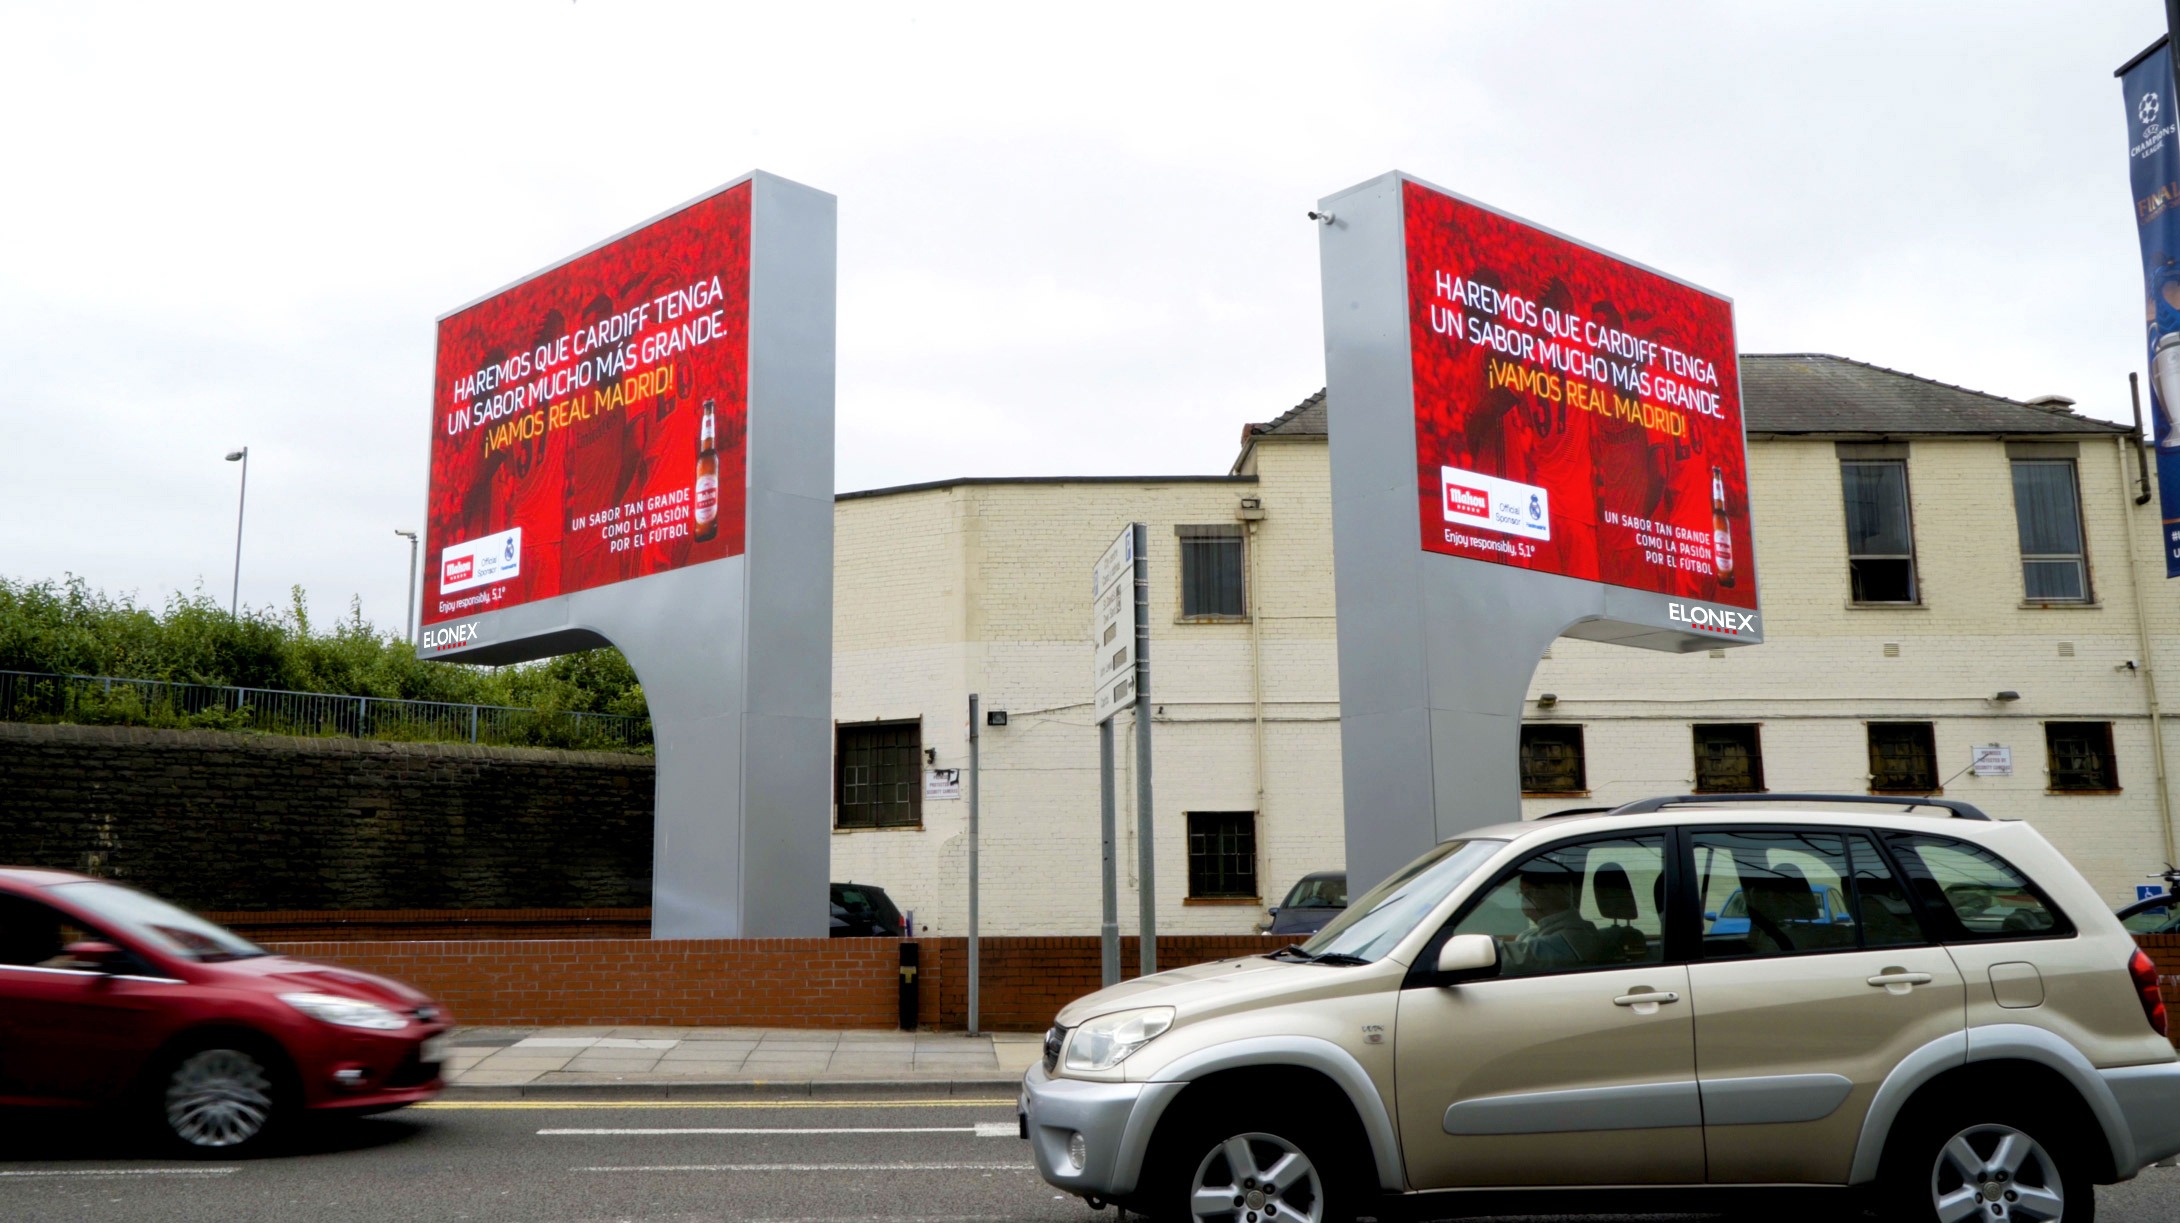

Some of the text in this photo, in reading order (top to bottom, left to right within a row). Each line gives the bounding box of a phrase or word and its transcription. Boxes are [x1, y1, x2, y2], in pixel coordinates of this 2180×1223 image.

[2131, 124, 2176, 157] CHAMPIONS
[2141, 139, 2164, 159] LEAGUE
[2138, 181, 2180, 217] FINAL
[454, 275, 723, 403] HAREMOS QUE CARDIFF TENGA
[1436, 269, 1718, 387] HAREMOS QUE CARDIFF TENGA
[448, 309, 728, 435] UN SABOR MUCHO MÁS GRANDE.
[1431, 304, 1725, 420] UN SABOR MUCHO MÁS GRANDE.
[485, 364, 674, 458] ¡VAMOS REAL MADRID!
[1489, 358, 1686, 438] ¡VAMOS REAL MADRID!
[572, 488, 690, 531] UN SABOR TAN GRANDE
[1450, 488, 1486, 508] Mahou
[1499, 503, 1521, 515] Official
[602, 505, 689, 539] COMO LA PASIÓN
[1495, 513, 1521, 526] Sponsor
[1604, 511, 1710, 546] UN SABOR TAN GRANDE
[610, 522, 689, 553] POR EL FÚTBOL
[1444, 528, 1469, 547] Enjoy
[1470, 536, 1517, 556] responsibly,
[1636, 533, 1663, 550] COMO
[1665, 538, 1677, 553] LA
[1680, 542, 1712, 560] PASIÓN
[446, 560, 471, 576] Mahou
[477, 566, 497, 577] Sponsor
[481, 556, 497, 566] Official
[1646, 550, 1713, 575] POR EL FÚTBOL
[439, 600, 456, 614] Enjoy
[456, 591, 490, 611] responsibly,
[1668, 602, 1755, 633] ELONEX
[424, 622, 477, 648] ELONEX
